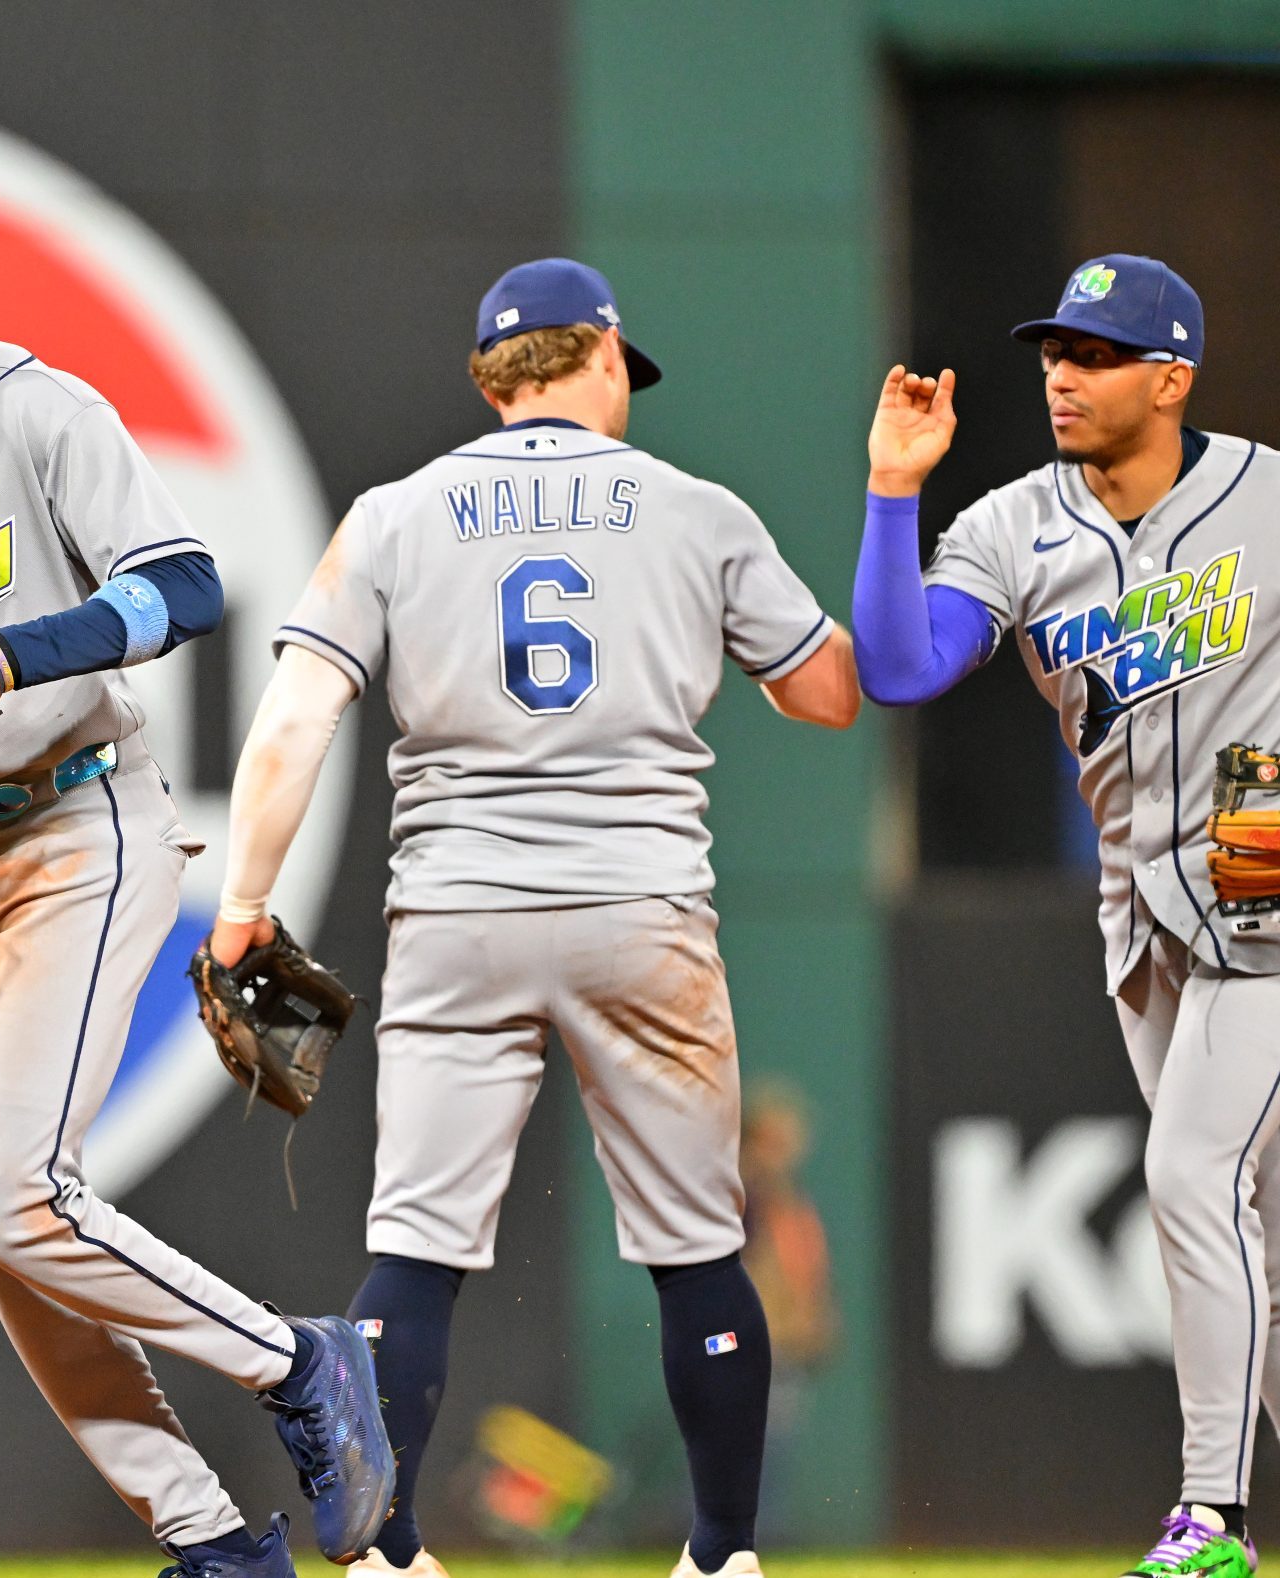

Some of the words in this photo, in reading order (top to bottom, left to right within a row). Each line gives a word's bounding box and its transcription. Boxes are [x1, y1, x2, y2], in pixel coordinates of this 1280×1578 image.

[442, 473, 641, 542] WALLS
[495, 552, 599, 716] 6
[1024, 546, 1245, 678] TAMPA
[1098, 586, 1258, 703] BAY
[932, 1116, 1176, 1368] K
